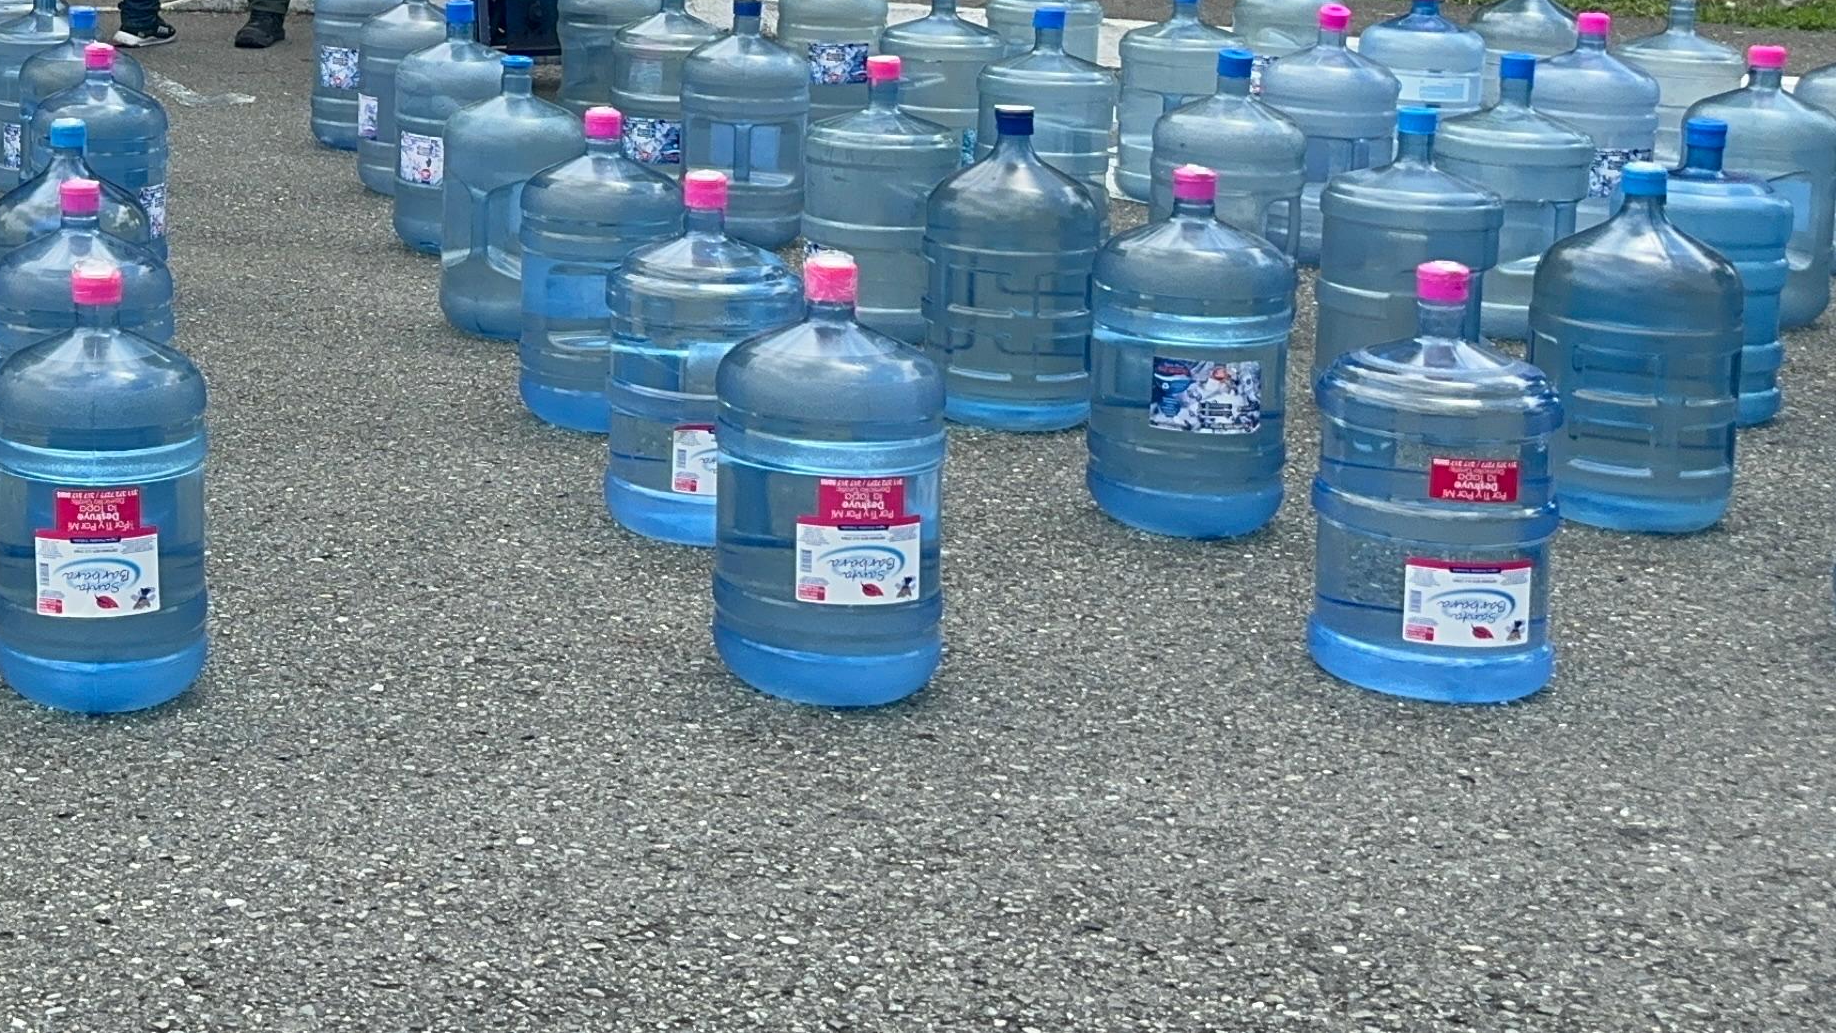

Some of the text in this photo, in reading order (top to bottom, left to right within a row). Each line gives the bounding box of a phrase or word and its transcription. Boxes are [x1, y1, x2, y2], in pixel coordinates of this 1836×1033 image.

[1457, 490, 1474, 500] Por
[1492, 491, 1507, 500] Por
[842, 500, 884, 510] Destruye
[77, 512, 119, 521] Destruye
[846, 510, 861, 519] Por
[879, 509, 894, 519] Por
[81, 523, 96, 531] Por
[115, 521, 132, 531] Por
[828, 557, 895, 570] Barbara
[62, 569, 129, 582] Barbara
[842, 570, 885, 582] Santa
[75, 581, 119, 593] Santa
[1436, 600, 1507, 612] Barbara
[1450, 612, 1497, 624] Santa
